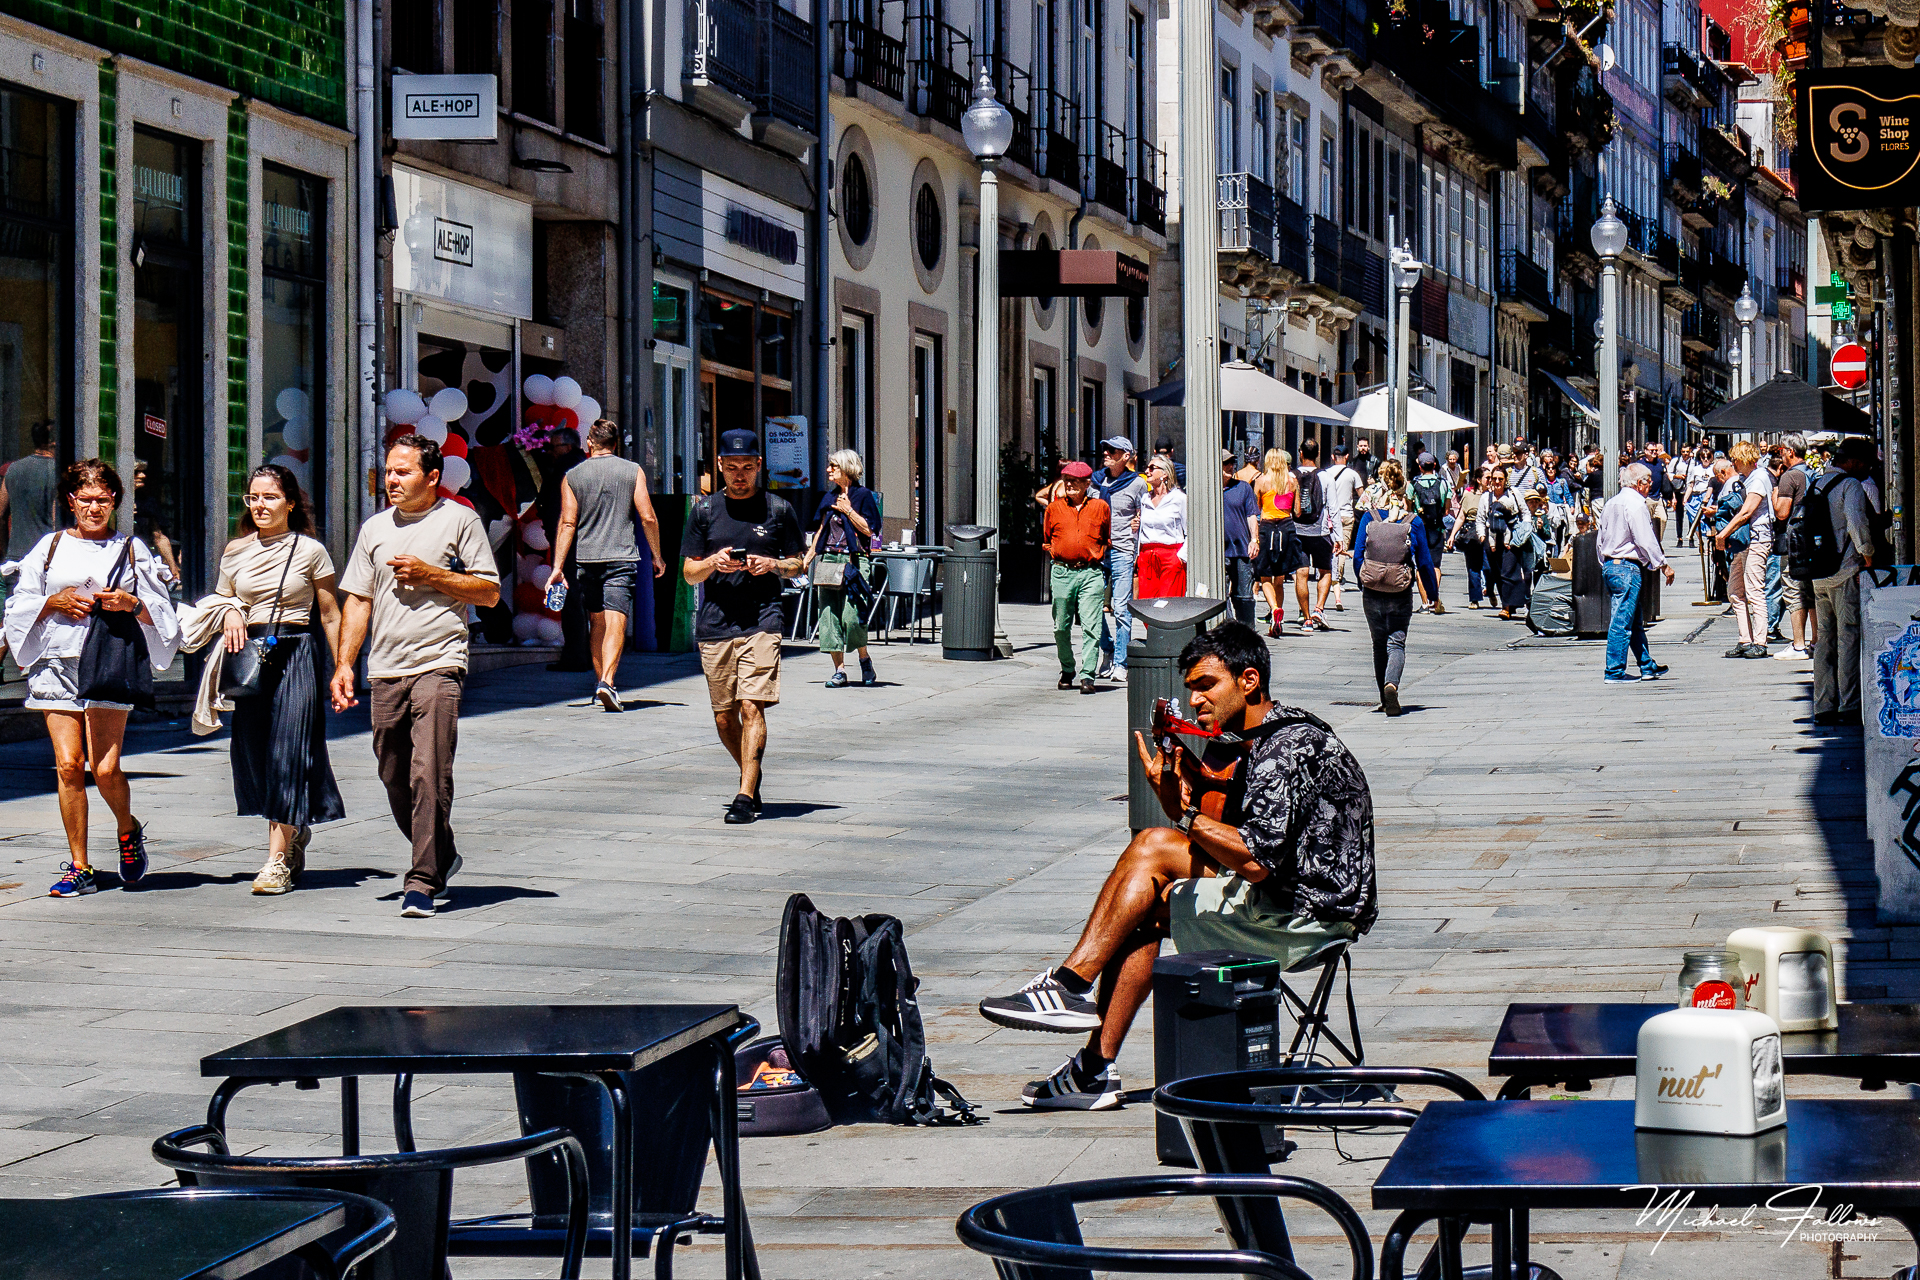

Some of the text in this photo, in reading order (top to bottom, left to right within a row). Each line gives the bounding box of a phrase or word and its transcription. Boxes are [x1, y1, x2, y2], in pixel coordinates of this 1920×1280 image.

[412, 99, 473, 112] ALE-HOP
[1879, 115, 1909, 126] Wine
[1879, 128, 1909, 141] Shop
[1880, 142, 1909, 151] FLORES
[437, 229, 470, 256] ALE-HOP
[146, 418, 166, 434] CLOSED
[1657, 1063, 1723, 1099] nut'
